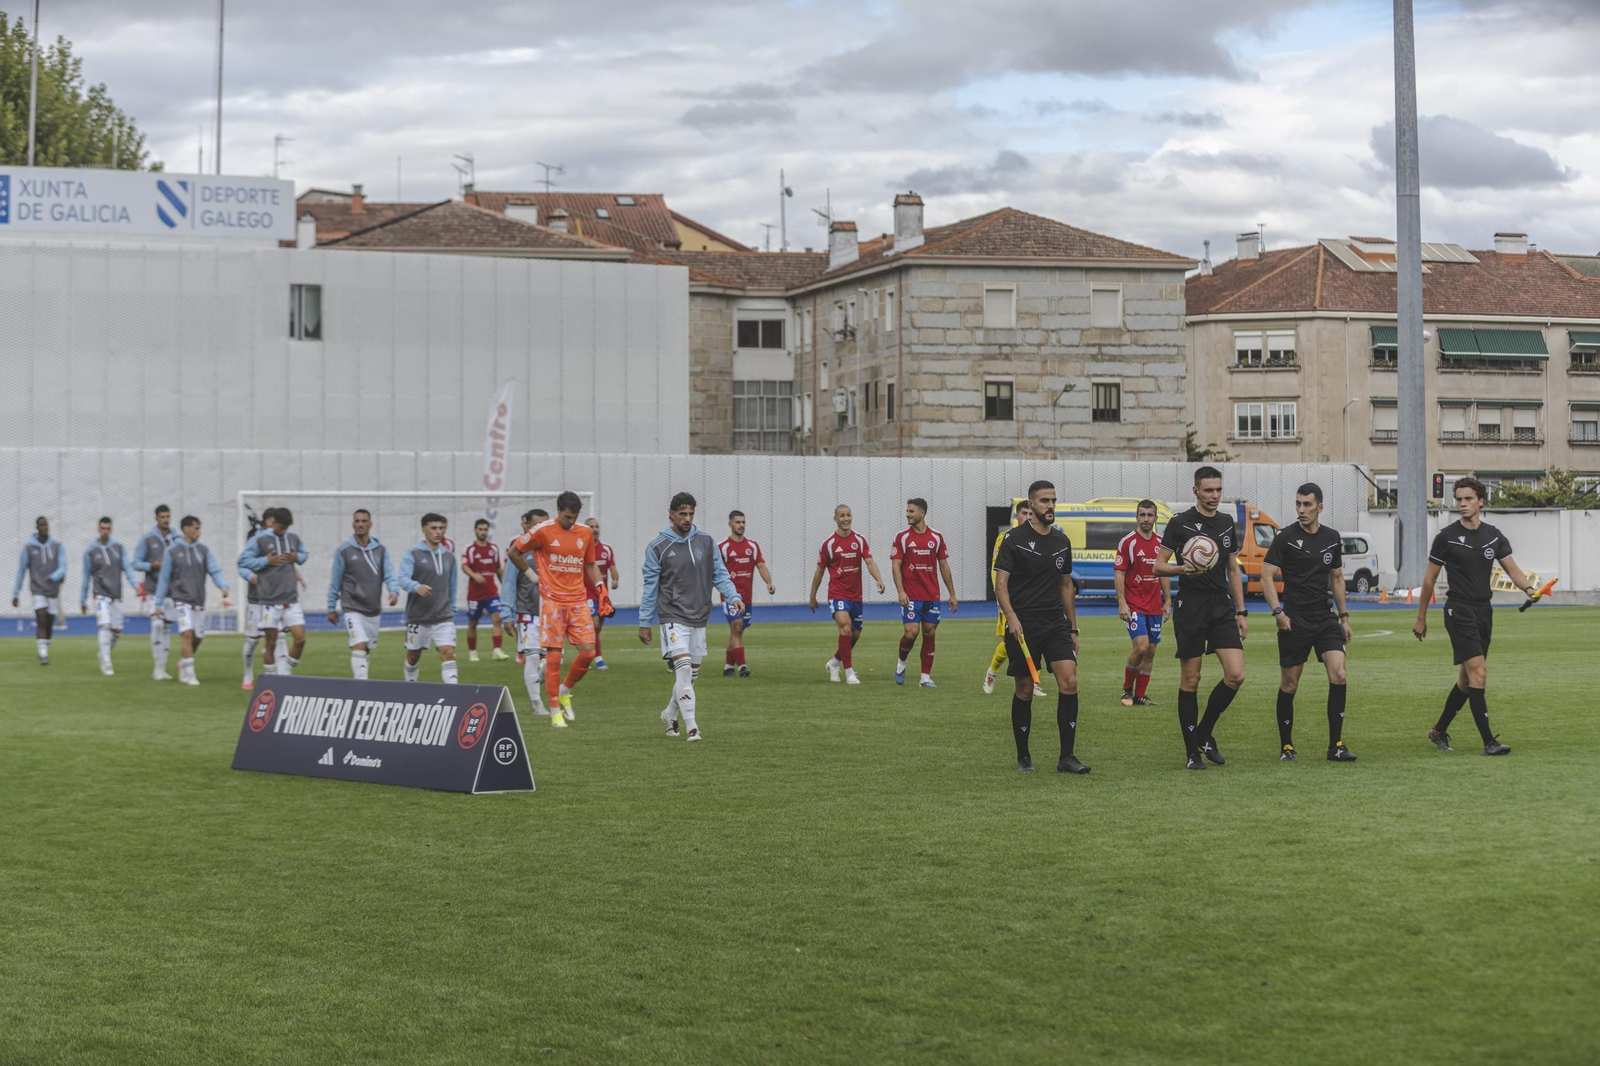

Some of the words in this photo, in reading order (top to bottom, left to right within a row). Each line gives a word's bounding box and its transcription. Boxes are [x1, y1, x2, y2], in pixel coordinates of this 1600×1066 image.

[19, 179, 88, 199] XUNTA
[201, 186, 280, 205] DEPORTE
[18, 202, 44, 221] DE
[50, 204, 132, 224] GALICIA
[201, 209, 273, 228] GALEGO
[483, 402, 507, 491] Centro
[558, 554, 584, 565] tvitec
[1070, 552, 1114, 560] ULANCIA
[837, 600, 845, 610] 9
[273, 694, 354, 739] PRIMERA
[347, 698, 458, 747] FEDERACIÓN
[469, 718, 479, 726] RF
[350, 754, 382, 768] Domino's
[499, 751, 512, 759] EF
